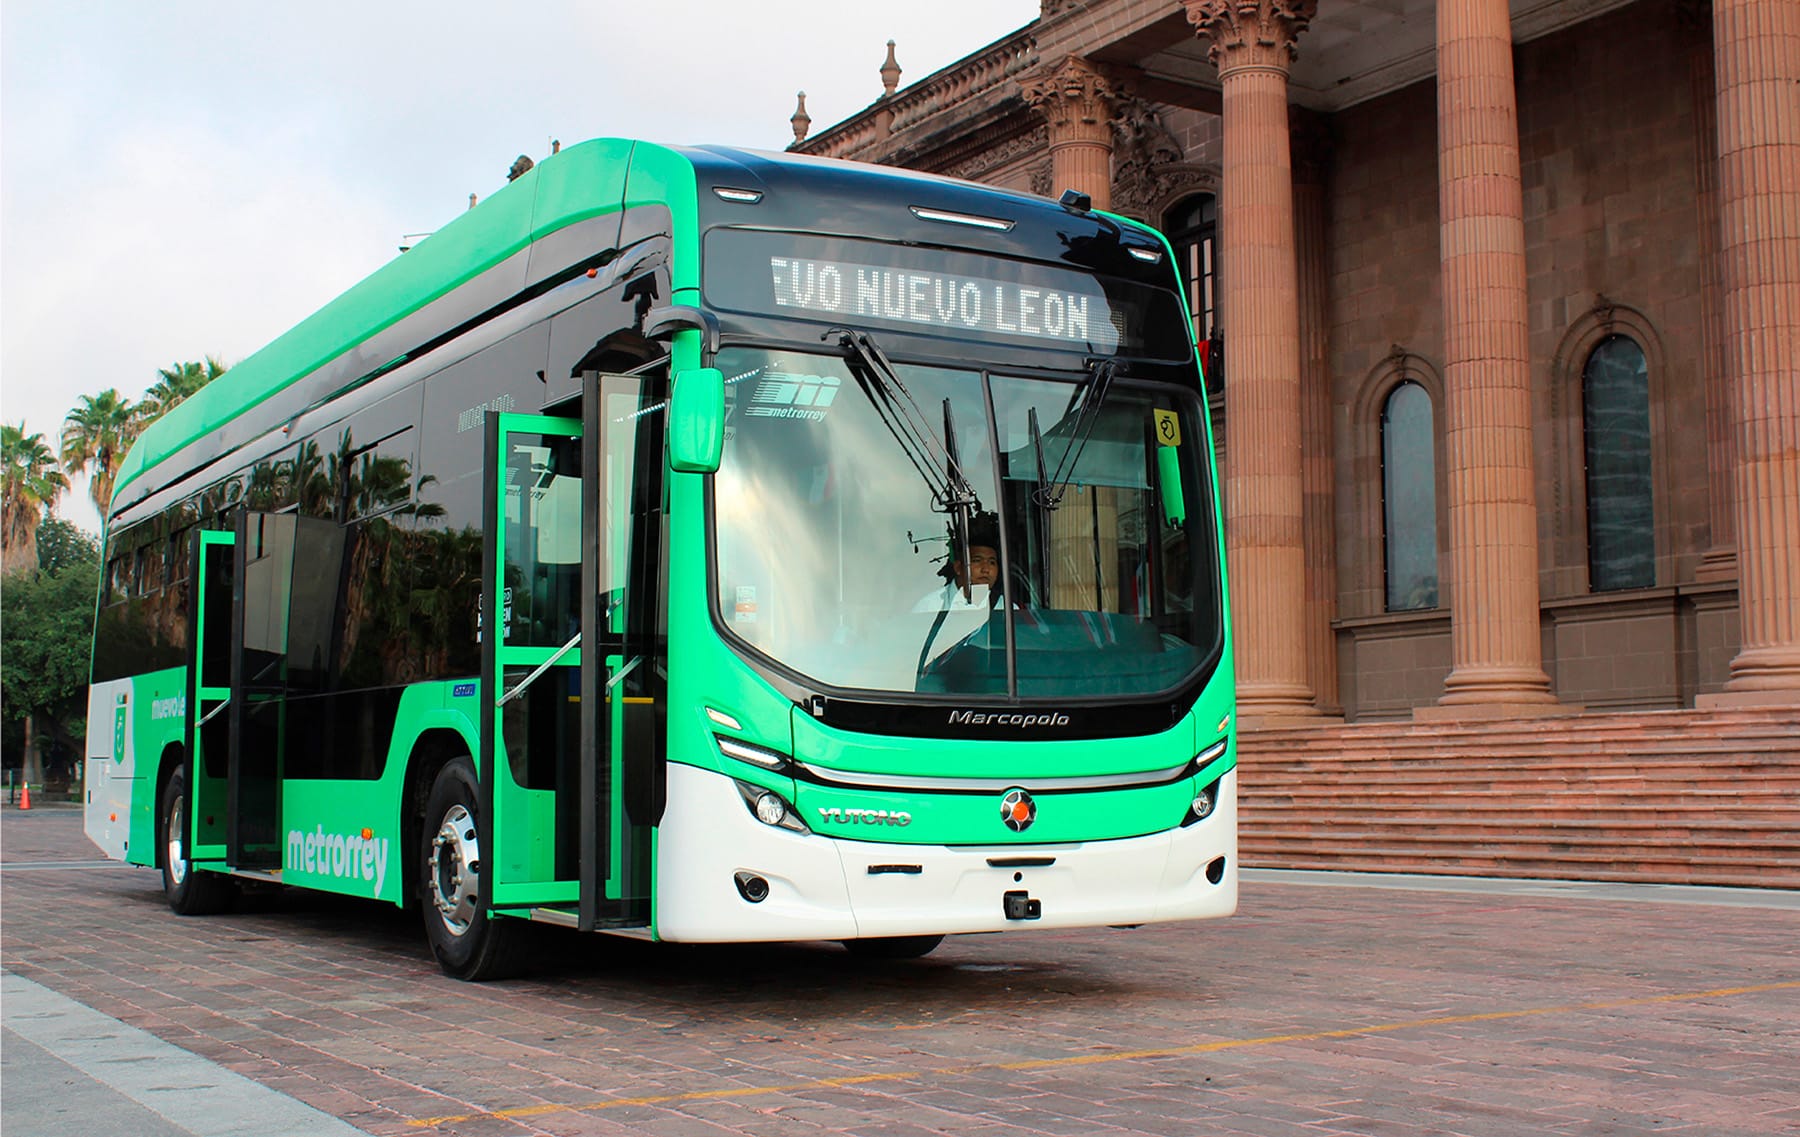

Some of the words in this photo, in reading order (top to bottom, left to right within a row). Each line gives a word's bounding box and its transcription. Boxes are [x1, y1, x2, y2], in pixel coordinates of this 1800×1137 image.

[857, 268, 981, 327] NUEVO
[995, 286, 1088, 339] LEON
[768, 406, 828, 423] metrorrey
[948, 710, 1070, 728] Marcopolo
[818, 807, 912, 827] YUTONG
[287, 823, 389, 899] metrorrey
